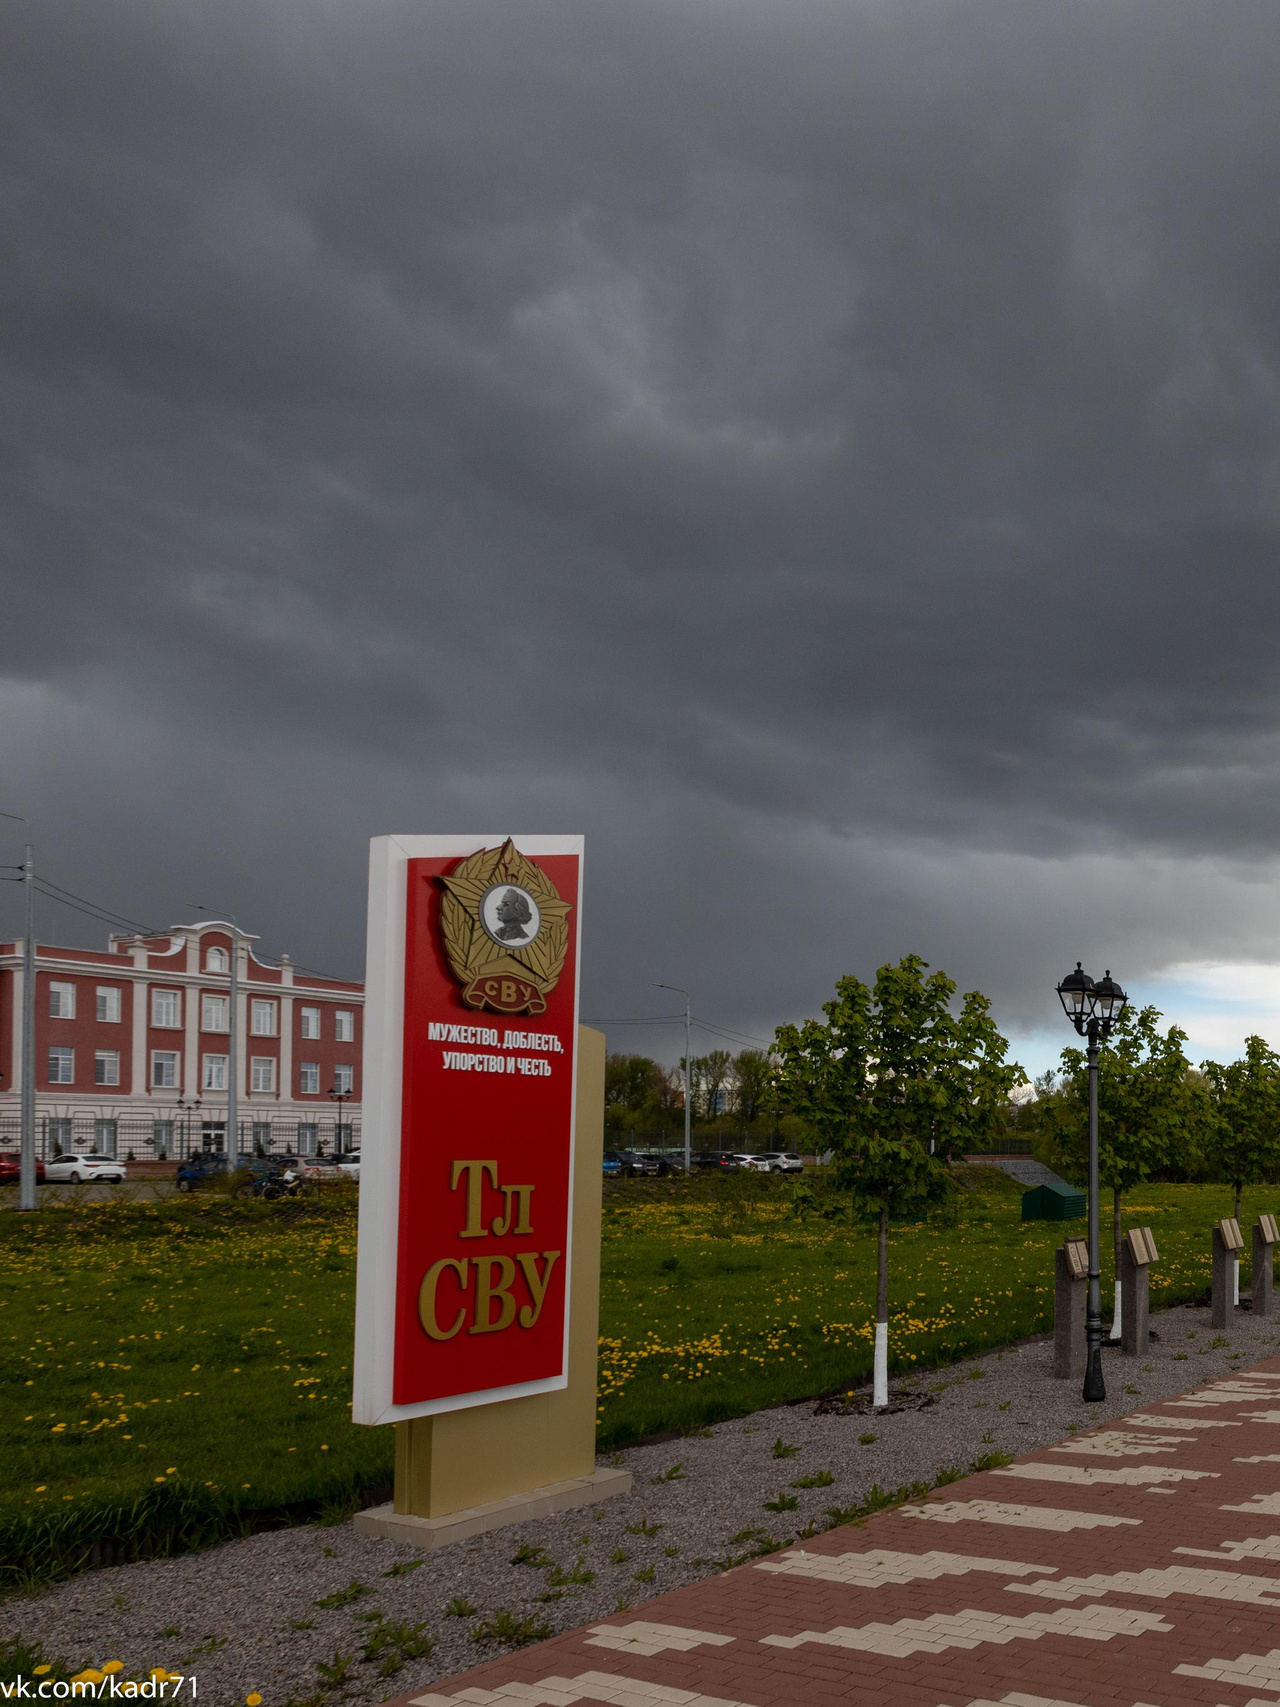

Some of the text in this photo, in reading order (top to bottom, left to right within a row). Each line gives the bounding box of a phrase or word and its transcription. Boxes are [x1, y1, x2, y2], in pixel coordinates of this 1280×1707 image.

[485, 981, 531, 1002] СВУ
[428, 1022, 564, 1053] МУЖЕСТВО, ДОБЛЕСТЬ,
[442, 1051, 552, 1076] УПОРСТВО И ЧЕСТЬ
[451, 1160, 535, 1238] Тл
[419, 1251, 561, 1341] СВУ
